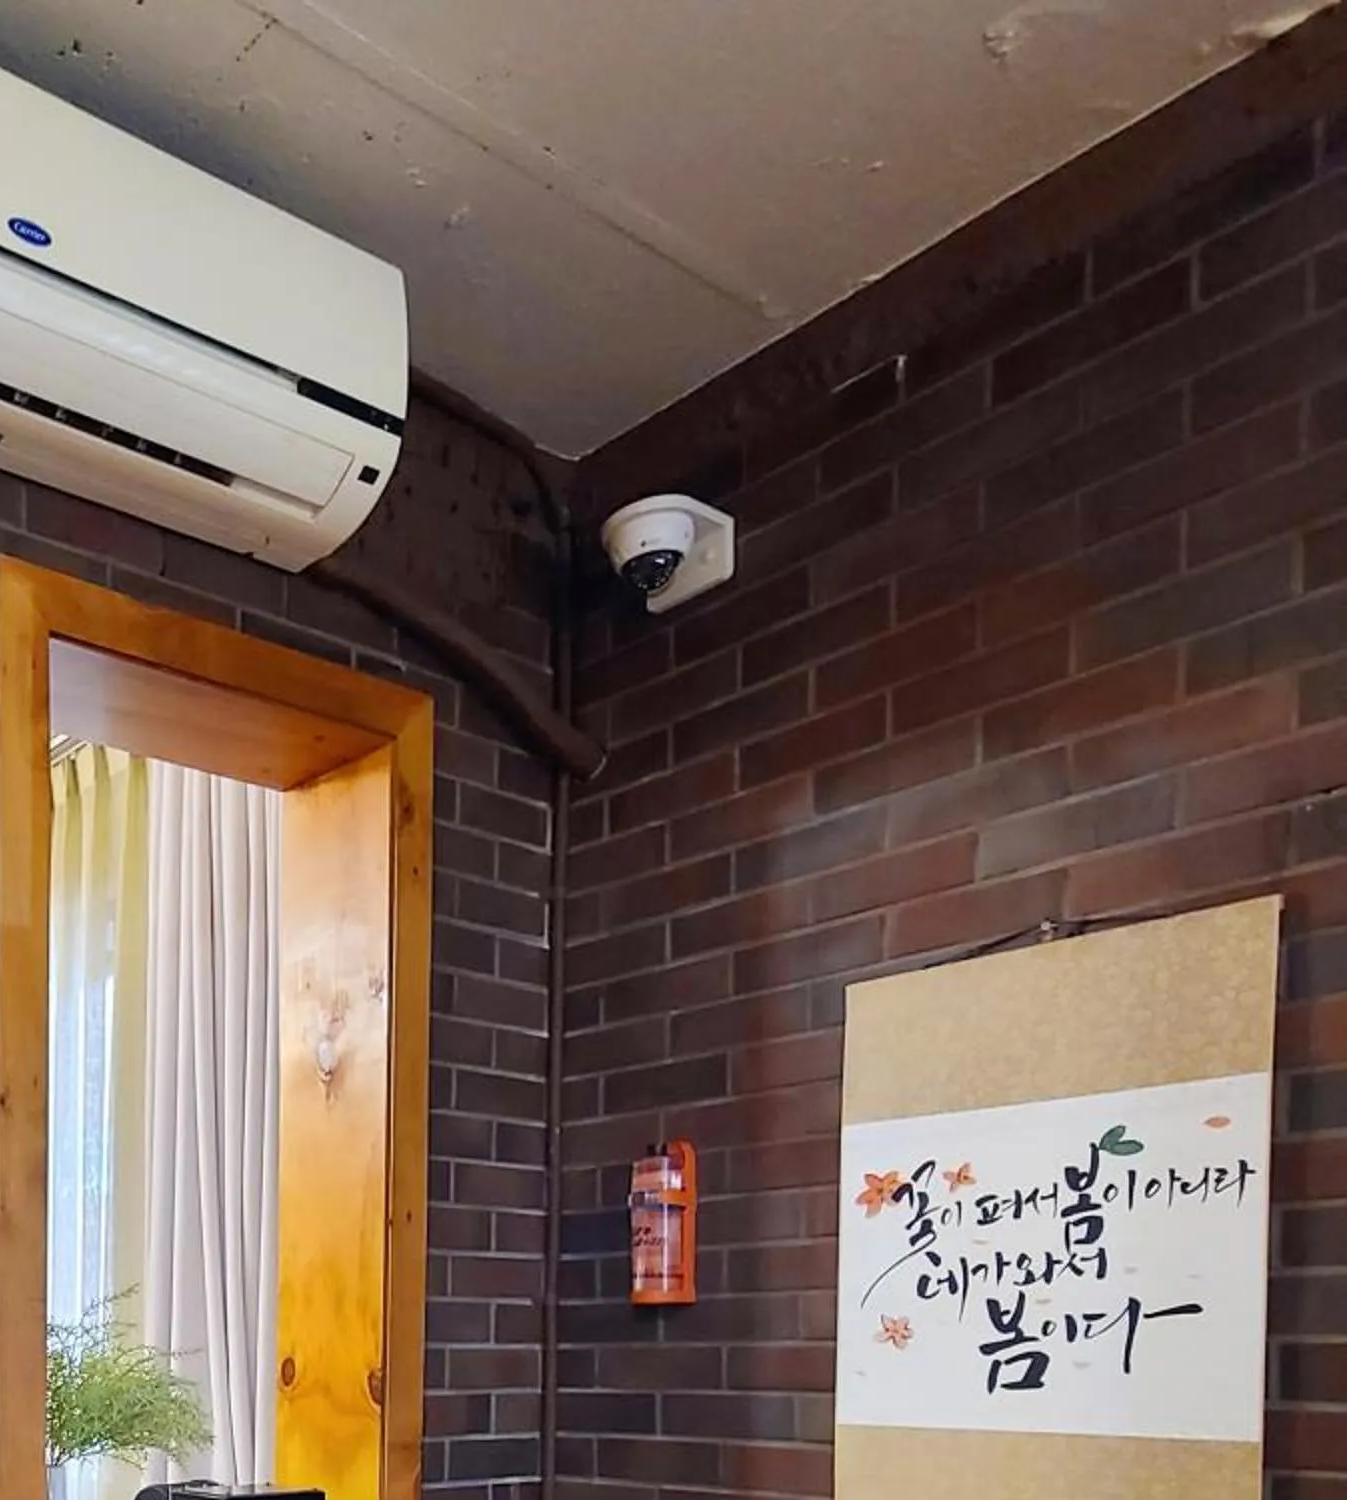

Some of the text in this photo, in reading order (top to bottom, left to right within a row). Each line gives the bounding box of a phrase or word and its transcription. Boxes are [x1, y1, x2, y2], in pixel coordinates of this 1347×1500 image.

[1060, 1141, 1138, 1254] 봄이
[1145, 1159, 1257, 1209] 아니라
[978, 1291, 1204, 1395] 봄이다
